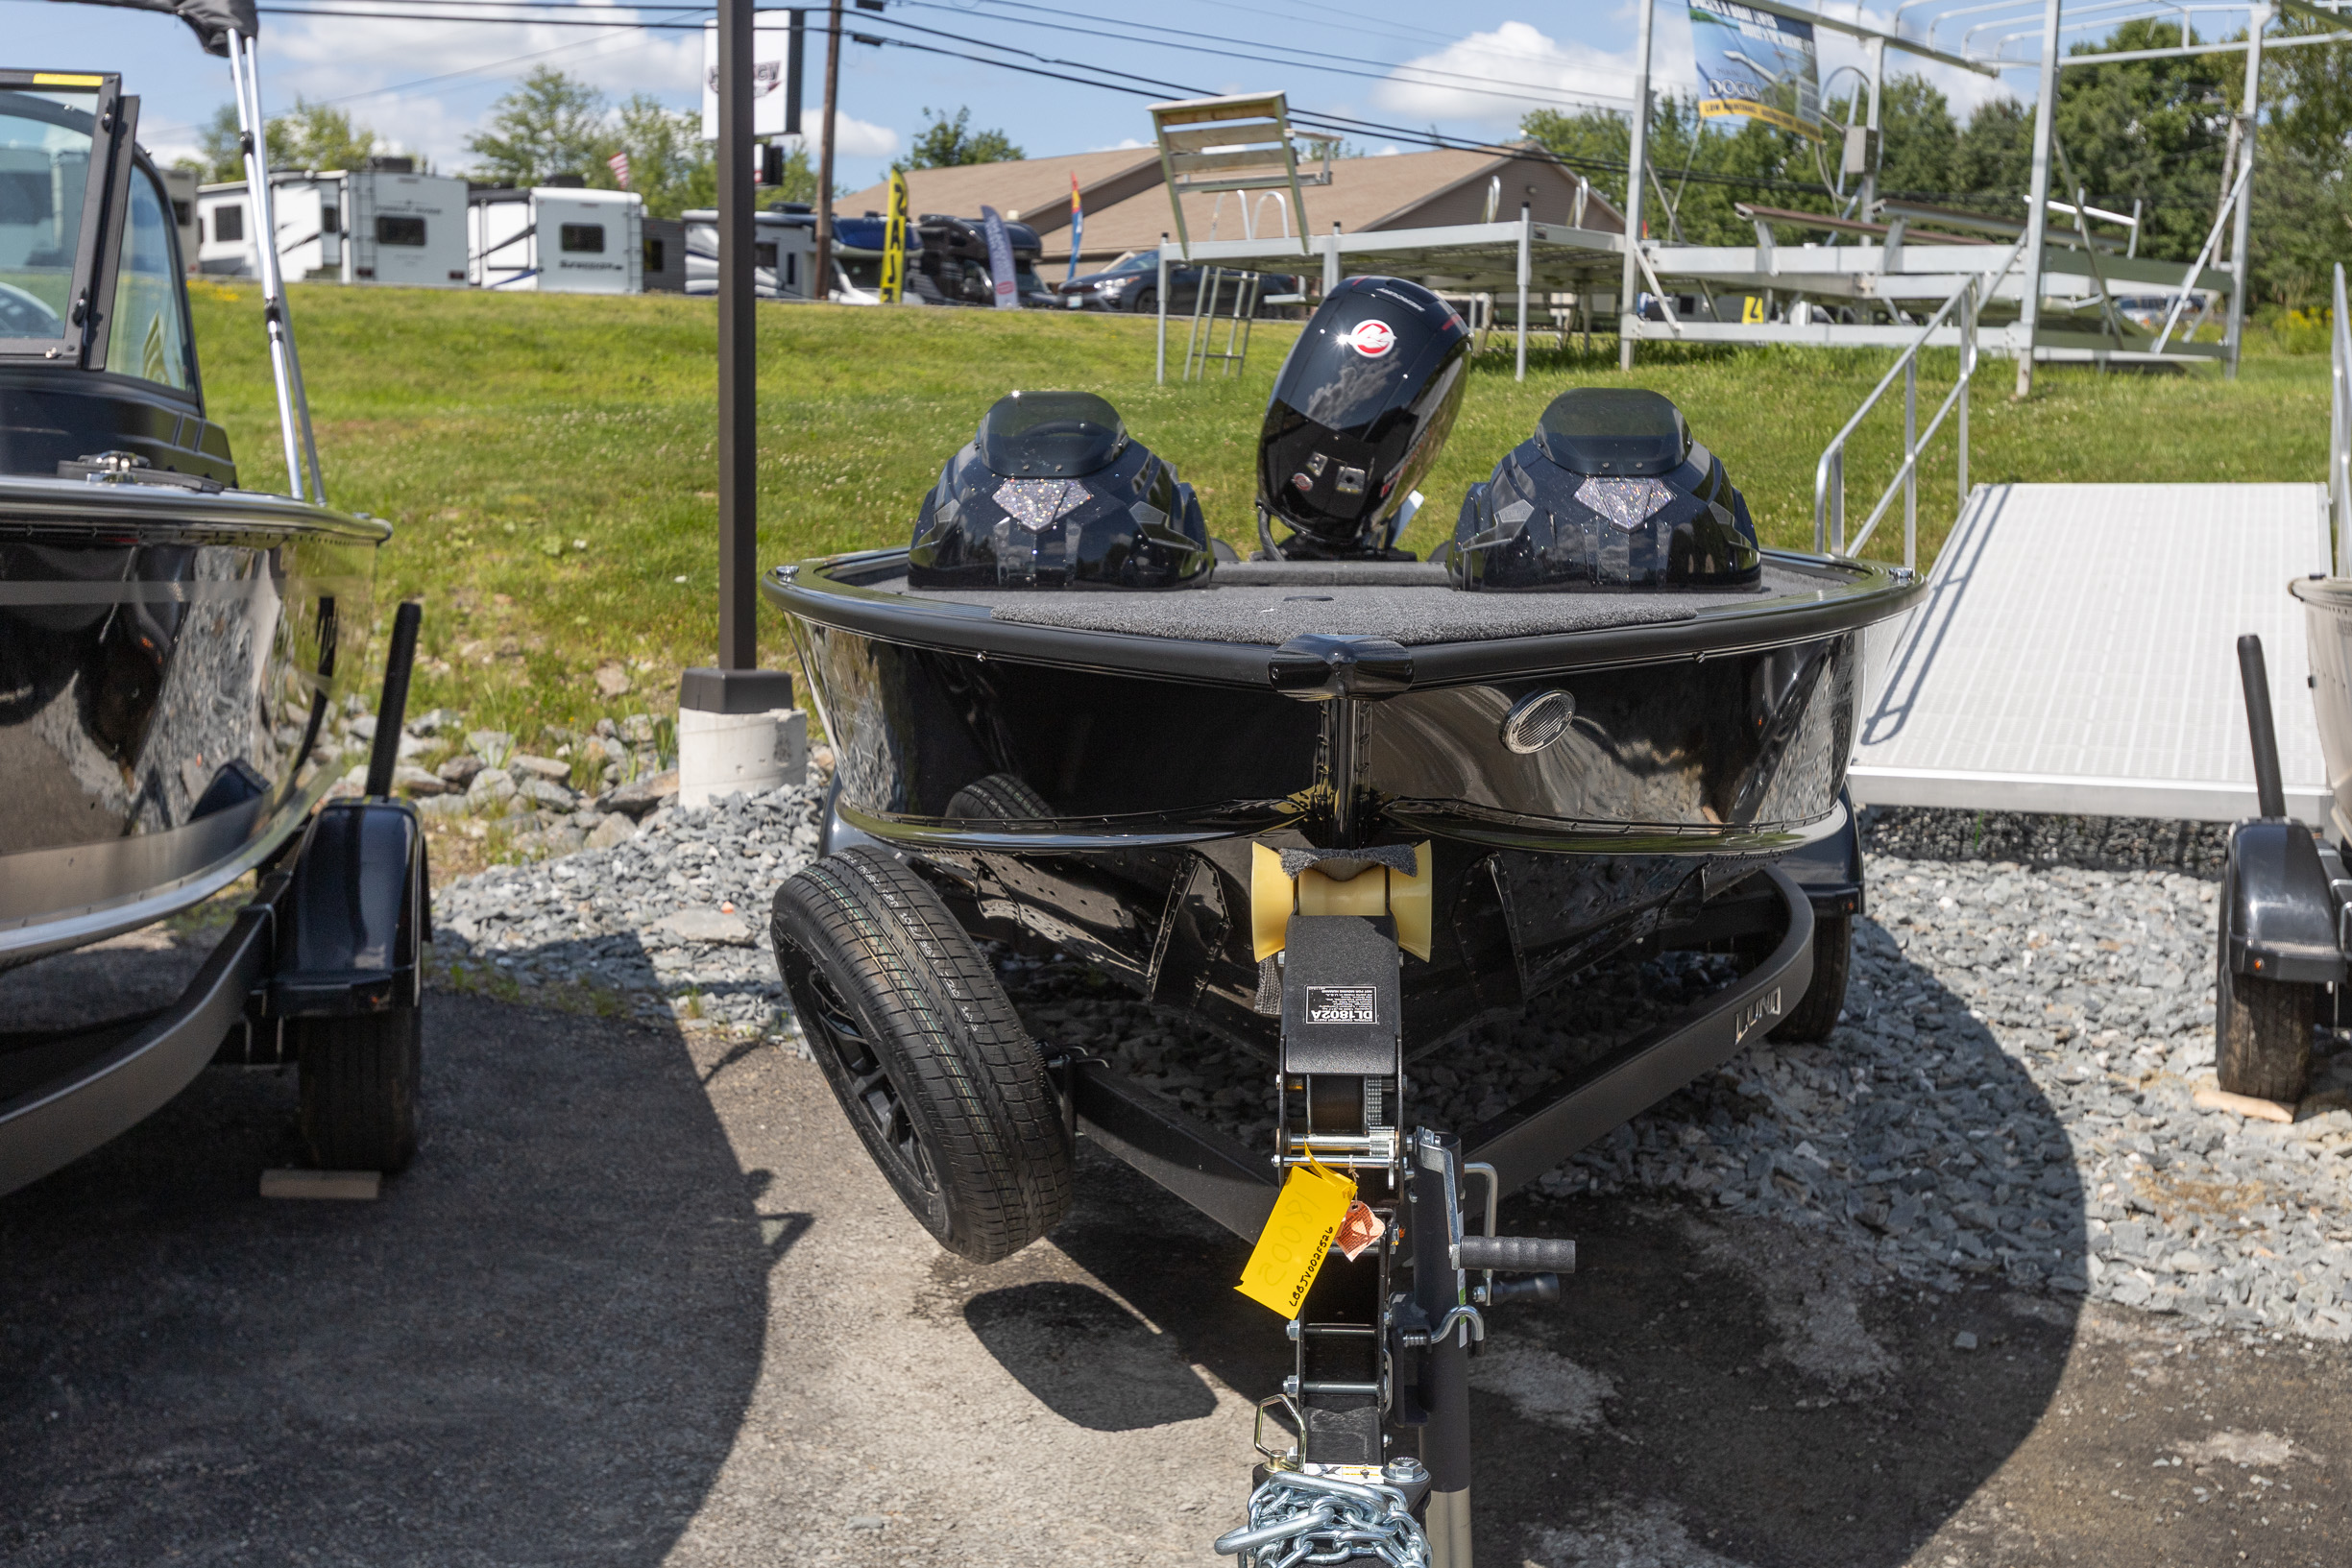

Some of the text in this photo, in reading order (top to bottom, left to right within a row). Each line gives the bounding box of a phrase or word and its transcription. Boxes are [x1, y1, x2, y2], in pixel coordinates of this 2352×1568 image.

[1708, 78, 1759, 101] DOCKS
[1375, 287, 1426, 312] MERCURY
[1311, 1010, 1372, 1019] DL1802A
[1734, 986, 1781, 1045] LUND
